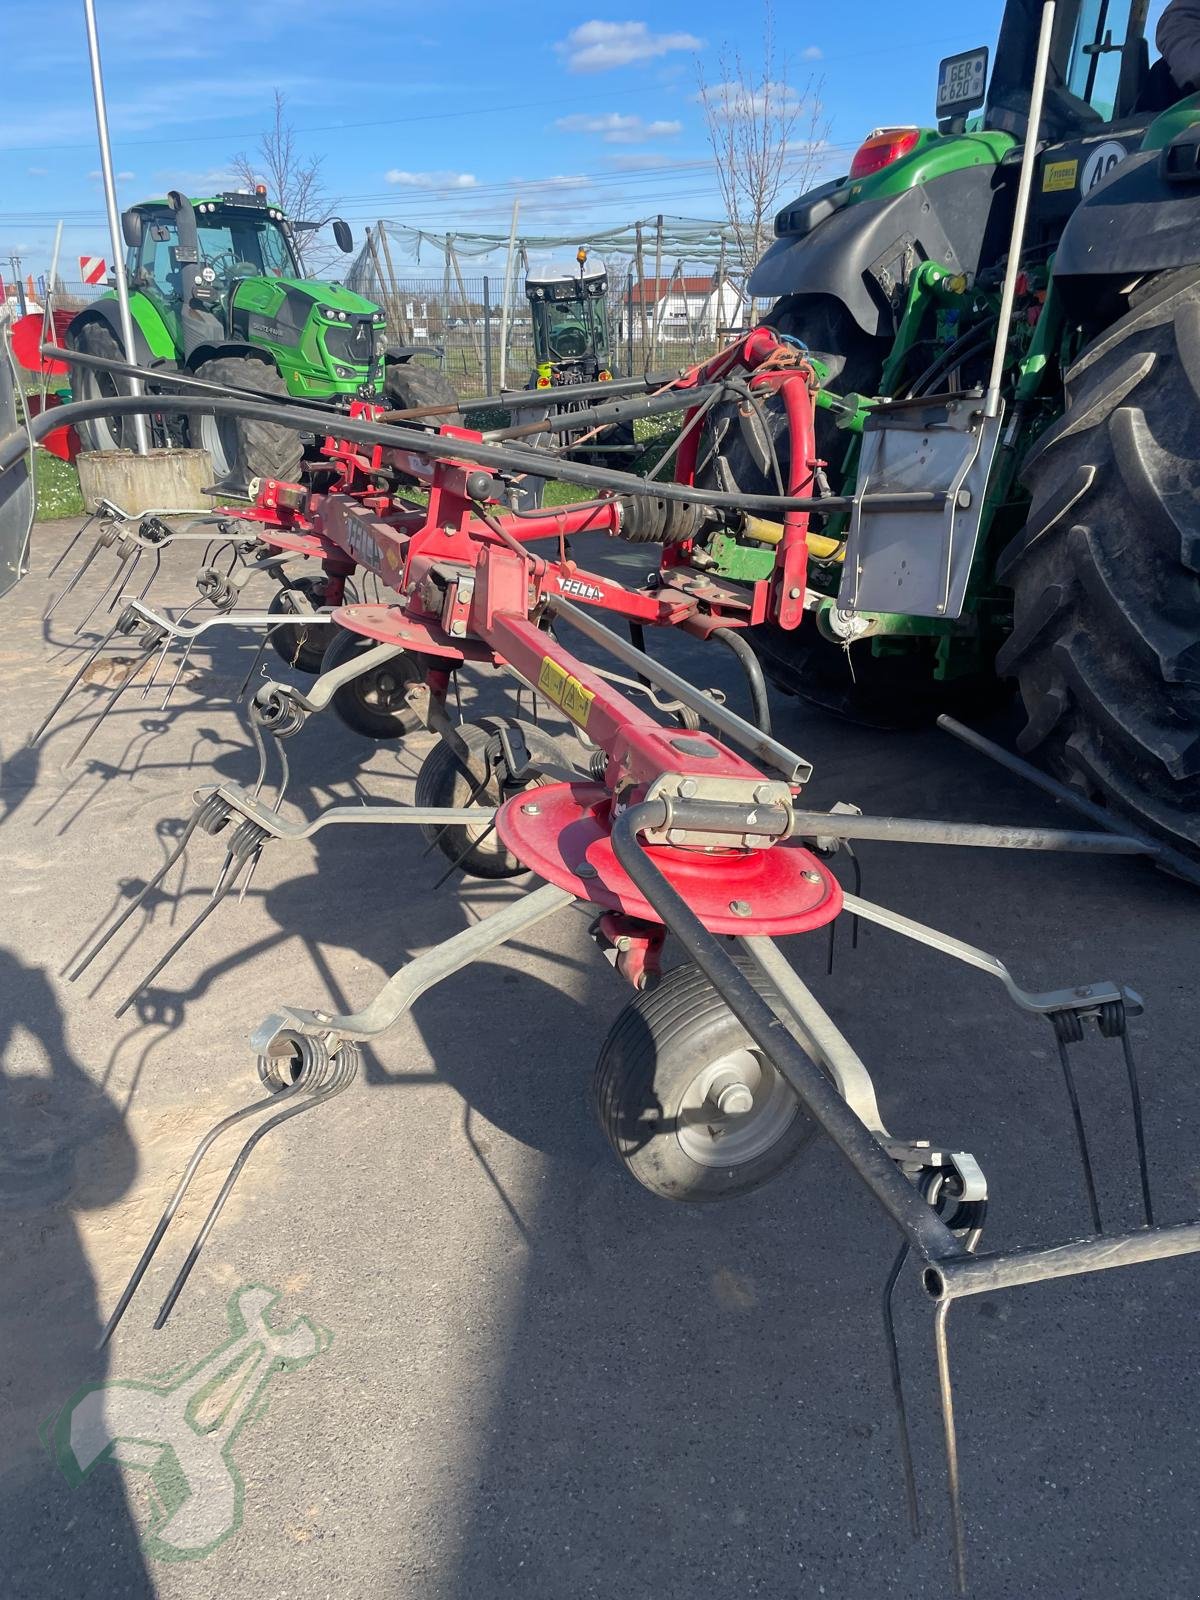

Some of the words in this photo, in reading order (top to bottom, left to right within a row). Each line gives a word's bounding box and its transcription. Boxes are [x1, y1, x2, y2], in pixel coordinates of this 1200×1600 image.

[951, 61, 973, 82] GER
[940, 85, 948, 101] C
[950, 80, 969, 99] 620
[560, 578, 600, 601] FELLA
